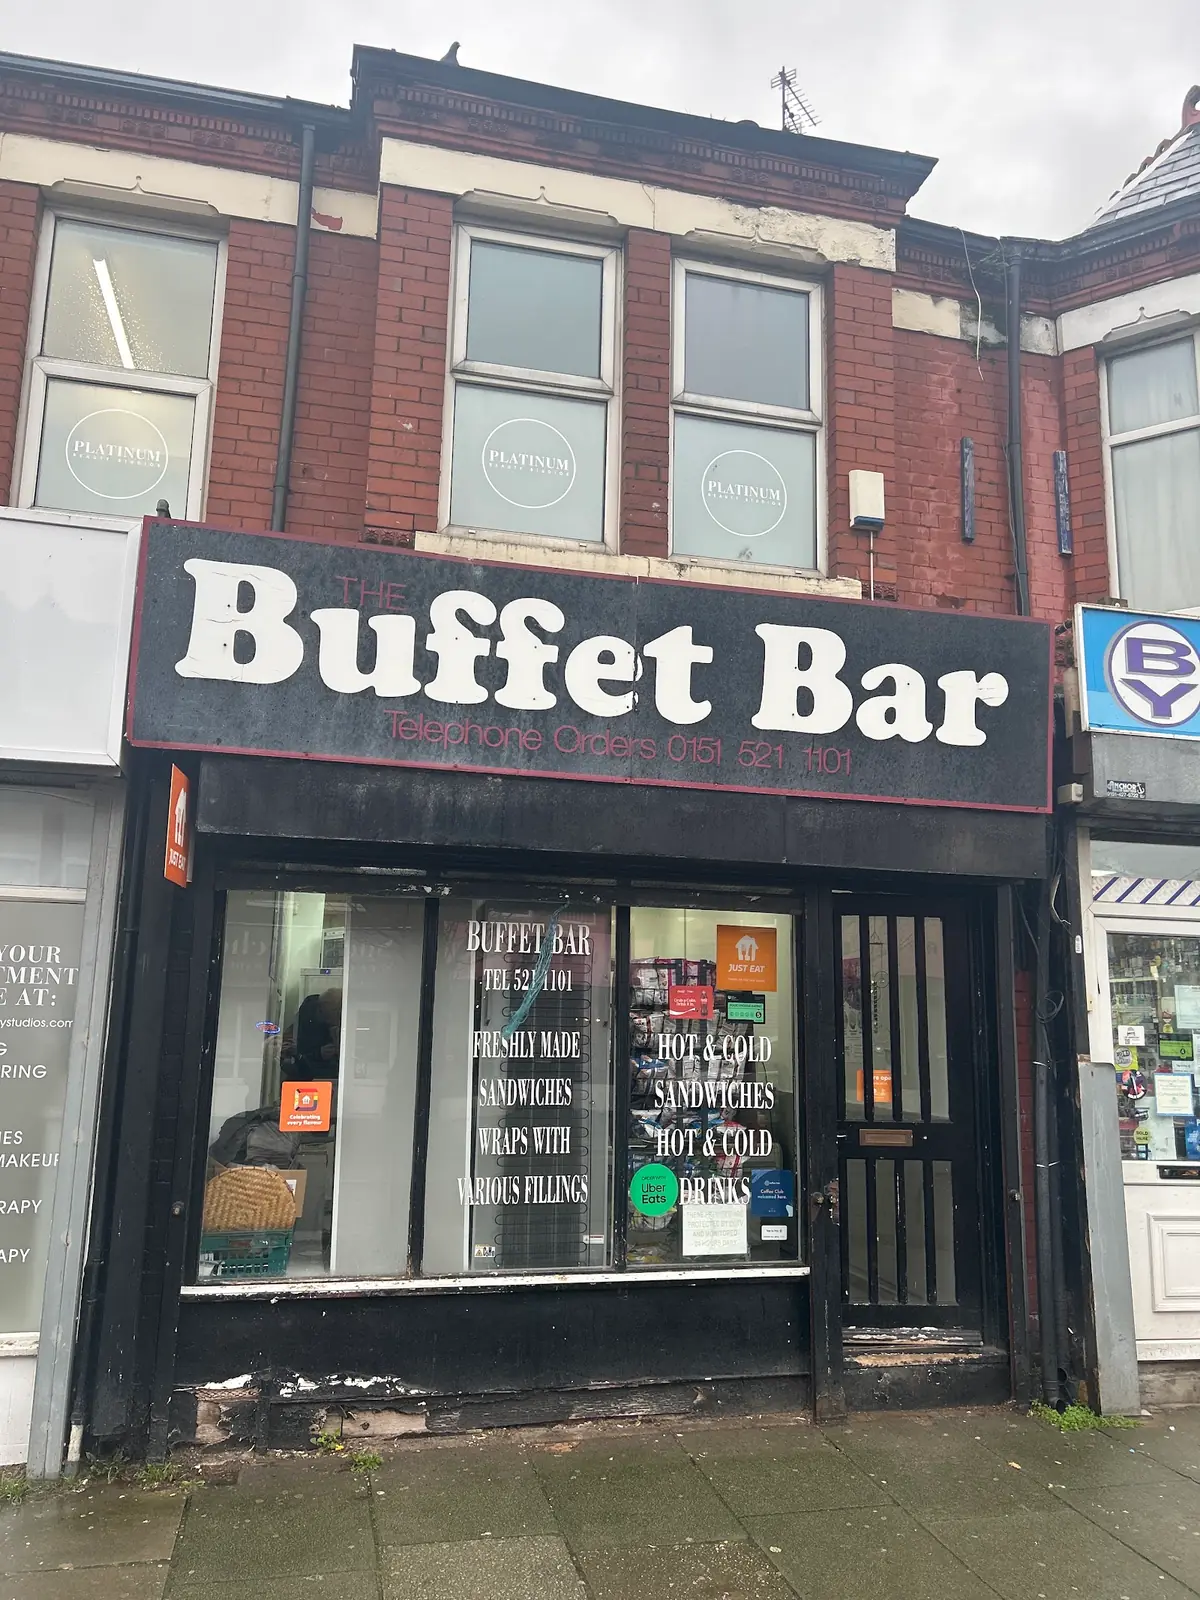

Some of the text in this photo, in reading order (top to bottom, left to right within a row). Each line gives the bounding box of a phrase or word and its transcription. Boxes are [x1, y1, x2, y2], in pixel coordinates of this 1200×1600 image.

[73, 440, 161, 462] PLATINUM
[489, 450, 569, 471] PLATINUM
[707, 480, 780, 501] PLATINUM
[336, 576, 408, 611] THE
[175, 558, 1010, 747] Buffet Bar
[384, 709, 852, 776] Telephone Orders 0151 521 1101
[466, 920, 591, 955] BUFFET BAR
[484, 968, 510, 991] TEL
[728, 964, 766, 973] JUST EAT
[15, 988, 56, 1006] AT:
[473, 1030, 581, 1058] FRESHLY MADE
[657, 1033, 772, 1062] HOT & COLD
[1, 1064, 47, 1079] RING
[479, 1078, 572, 1106] SANDWICHES
[654, 1080, 774, 1110] SANDWICHES
[0, 1131, 23, 1145] ES
[478, 1126, 571, 1155] WRAPS WITH
[656, 1128, 773, 1157] HOT & COLD
[457, 1174, 588, 1206] VARIOUS FILLINGS
[641, 1183, 666, 1193] Uber
[641, 1194, 667, 1204] Eats
[679, 1176, 751, 1206] DRINKS
